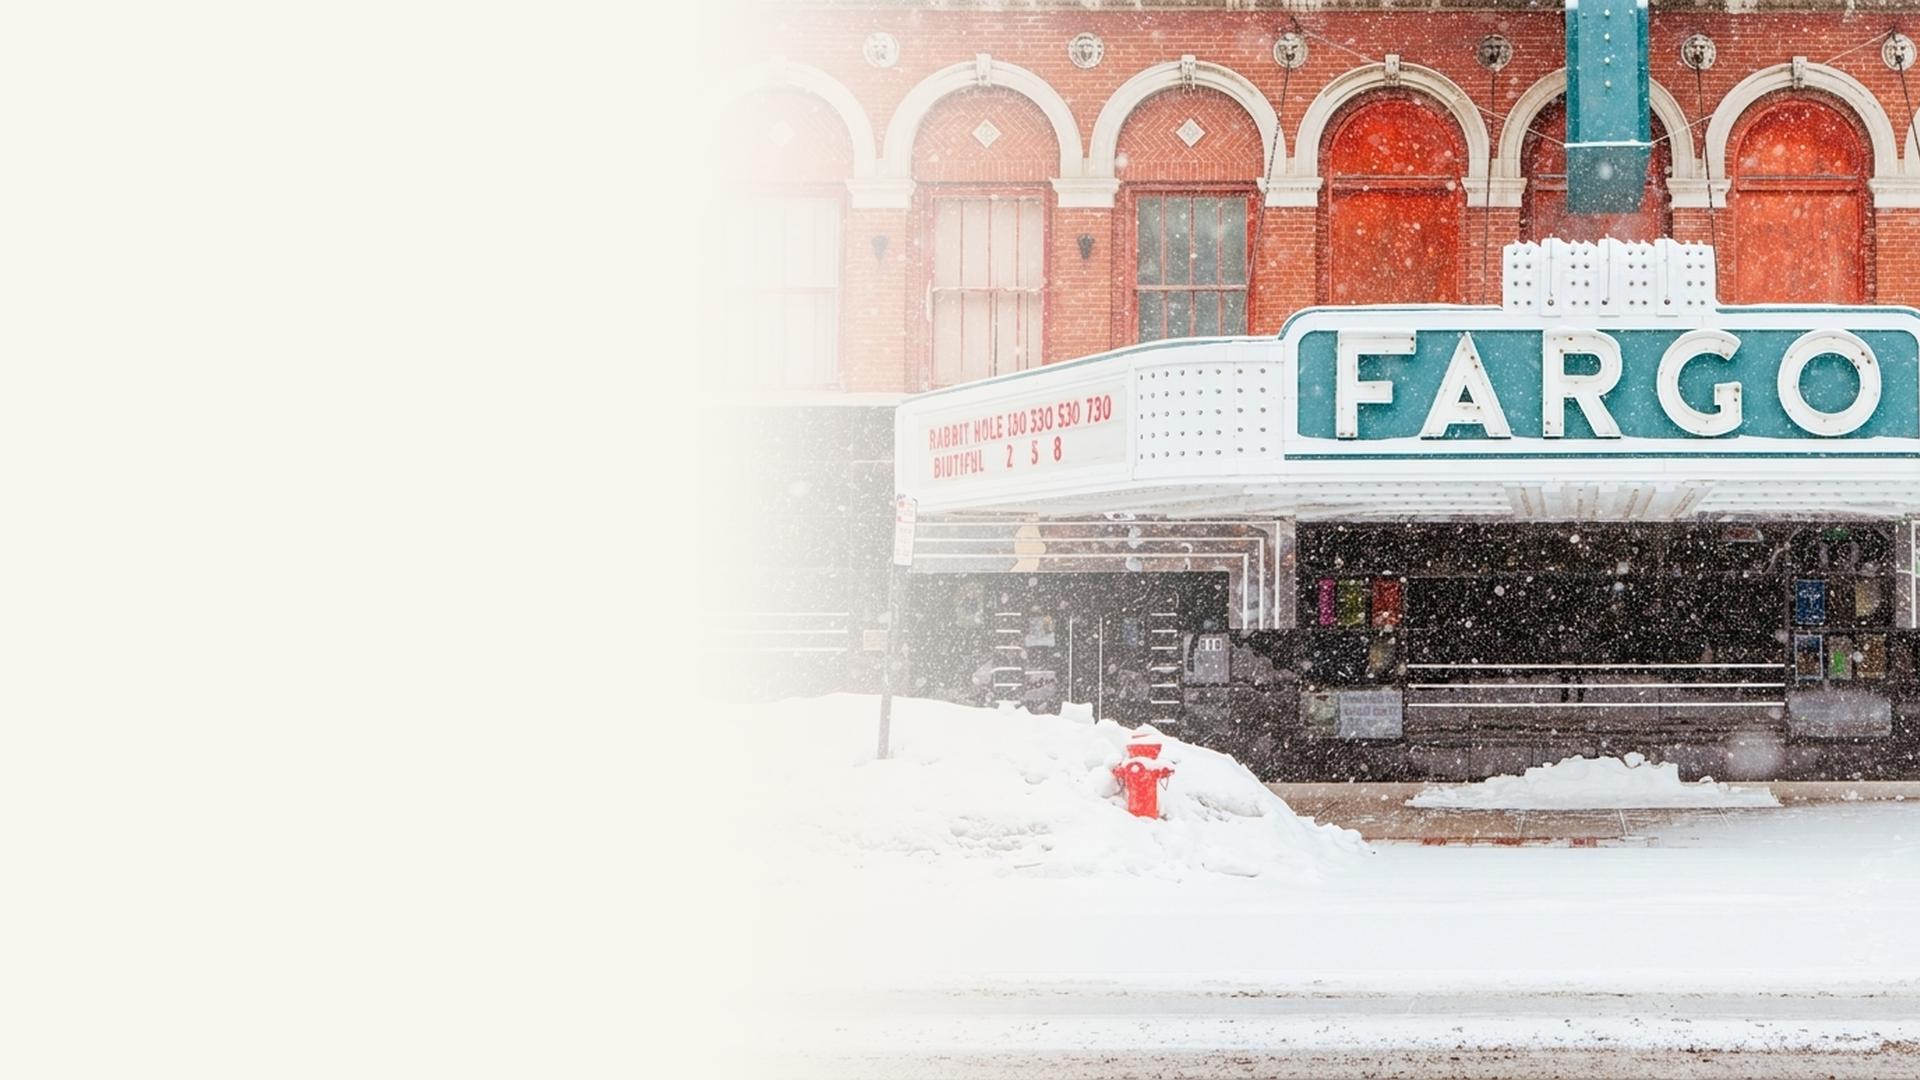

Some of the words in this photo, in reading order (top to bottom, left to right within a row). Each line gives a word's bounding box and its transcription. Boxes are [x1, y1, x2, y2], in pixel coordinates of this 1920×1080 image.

[1336, 328, 1881, 440] FARGO
[974, 415, 1003, 443] HOLE
[1030, 405, 1053, 433] 330
[1057, 400, 1081, 428] 530
[1086, 395, 1112, 423] 730
[933, 450, 984, 479] BIUTIFUL
[1006, 444, 1013, 468] 2
[1031, 440, 1039, 465] 5
[1053, 436, 1062, 462] 8
